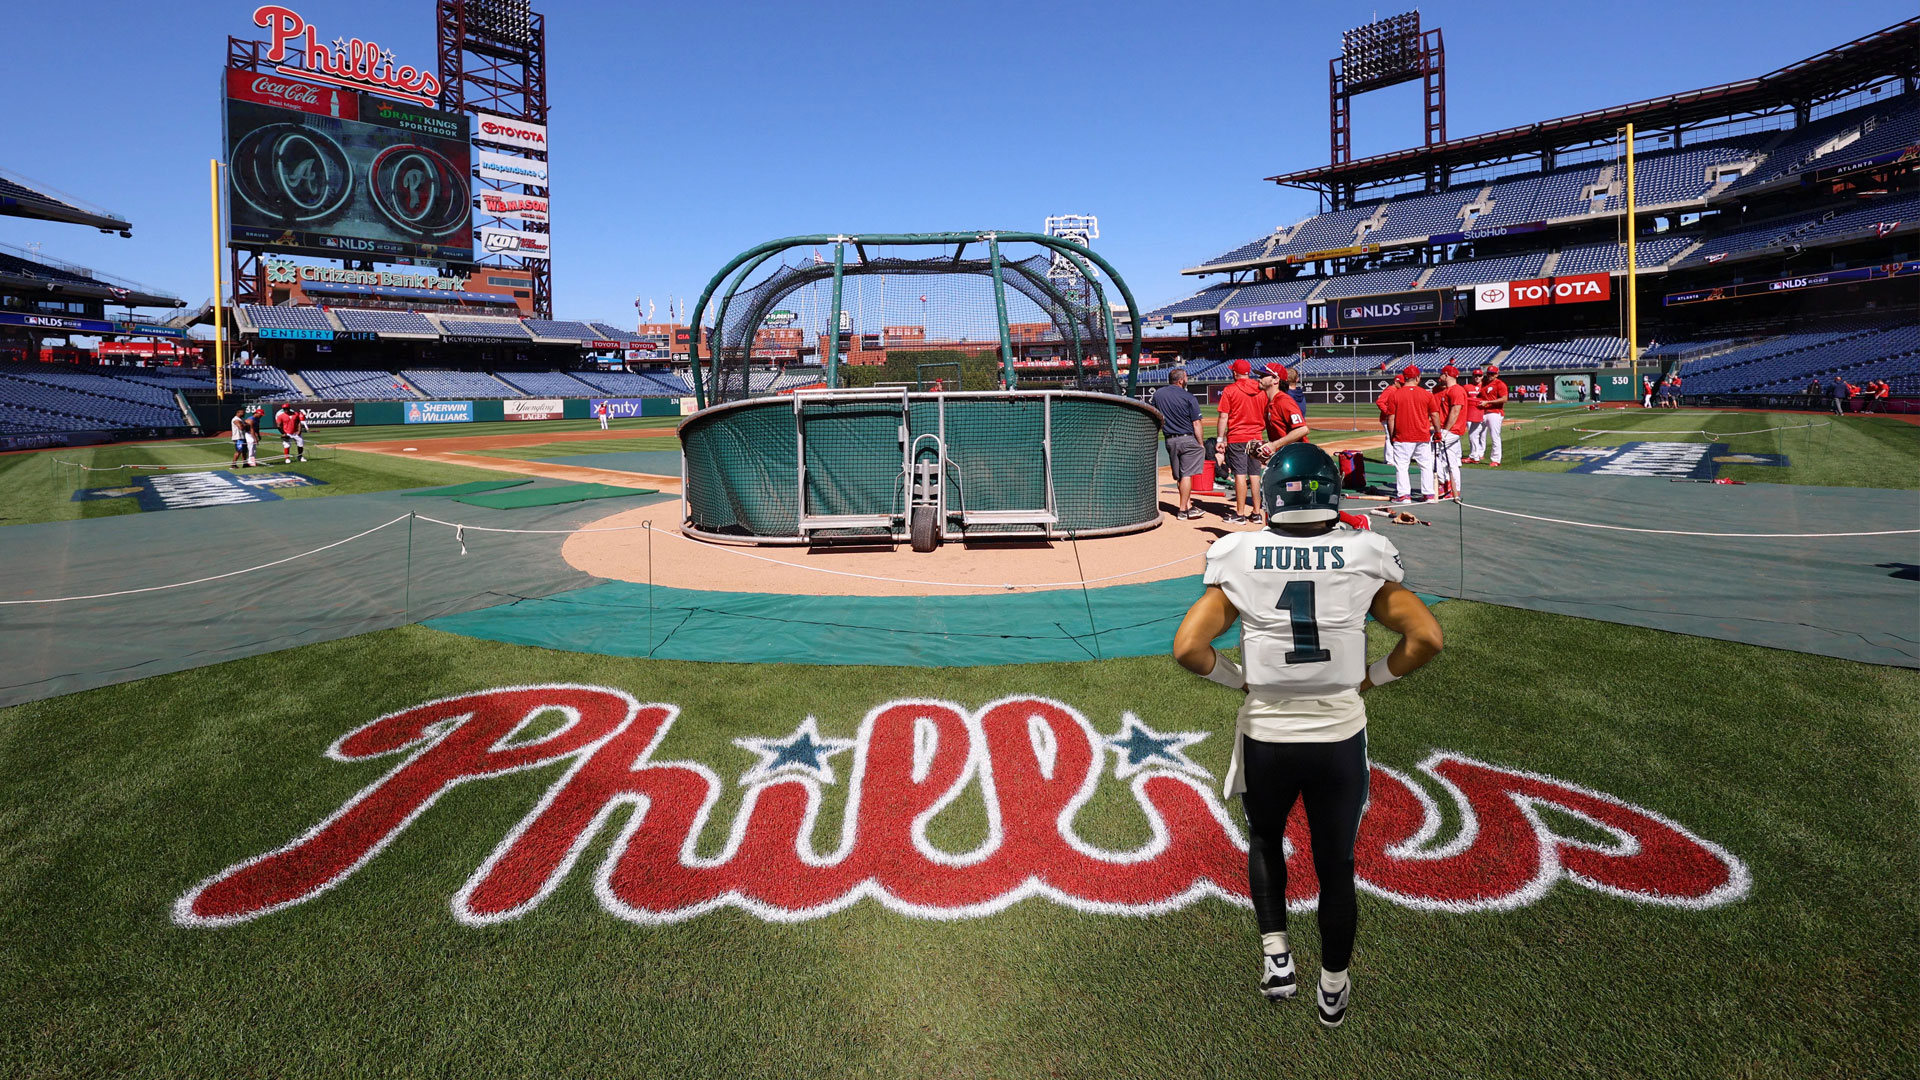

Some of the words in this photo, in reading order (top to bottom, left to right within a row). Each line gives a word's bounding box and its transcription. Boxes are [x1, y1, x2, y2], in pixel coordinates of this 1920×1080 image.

[253, 5, 441, 96] Phillies
[251, 76, 320, 104] Coca-Cola
[399, 121, 457, 137] SPORTSBOOK
[497, 125, 545, 144] TOYOTA
[1837, 160, 1873, 174] ATLANTA
[1463, 227, 1508, 240] StubHub
[339, 237, 375, 251] NLDS
[299, 265, 378, 284] Citizens
[381, 271, 425, 287] Bank
[428, 275, 465, 291] Park
[1782, 278, 1807, 289] NLDS
[1514, 280, 1602, 300] TOYOTA
[1243, 307, 1302, 323] LifeBrand
[1363, 303, 1401, 318] NLDS
[1403, 303, 1434, 312] 2022
[38, 316, 63, 327] NLDS
[260, 329, 331, 339] DENTISTRY
[351, 332, 376, 340] LIFE
[448, 336, 502, 344] KLYRRUM.COM
[1612, 376, 1629, 385] 330
[300, 408, 353, 419] NovaCare
[423, 403, 468, 412] SHERWIN
[1254, 546, 1345, 570] HURTS
[1275, 580, 1331, 664] 1
[171, 682, 1752, 927] Phillis
